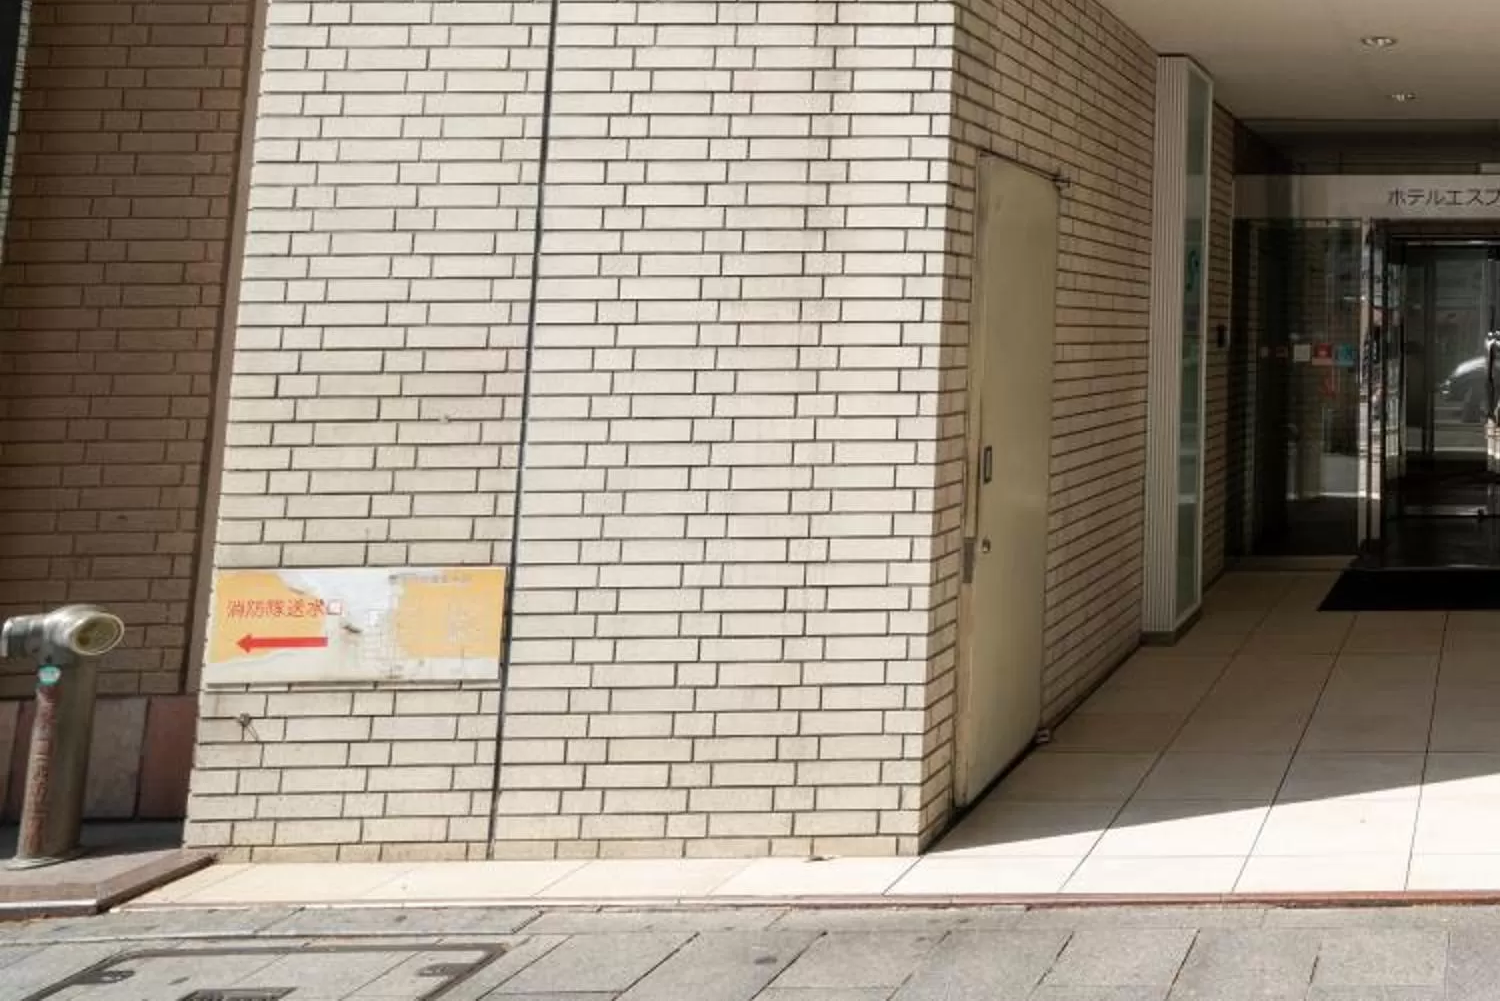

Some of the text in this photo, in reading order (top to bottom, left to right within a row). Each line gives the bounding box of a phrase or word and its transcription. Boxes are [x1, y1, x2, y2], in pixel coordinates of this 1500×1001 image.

[227, 598, 343, 617] 消防隊送水口
